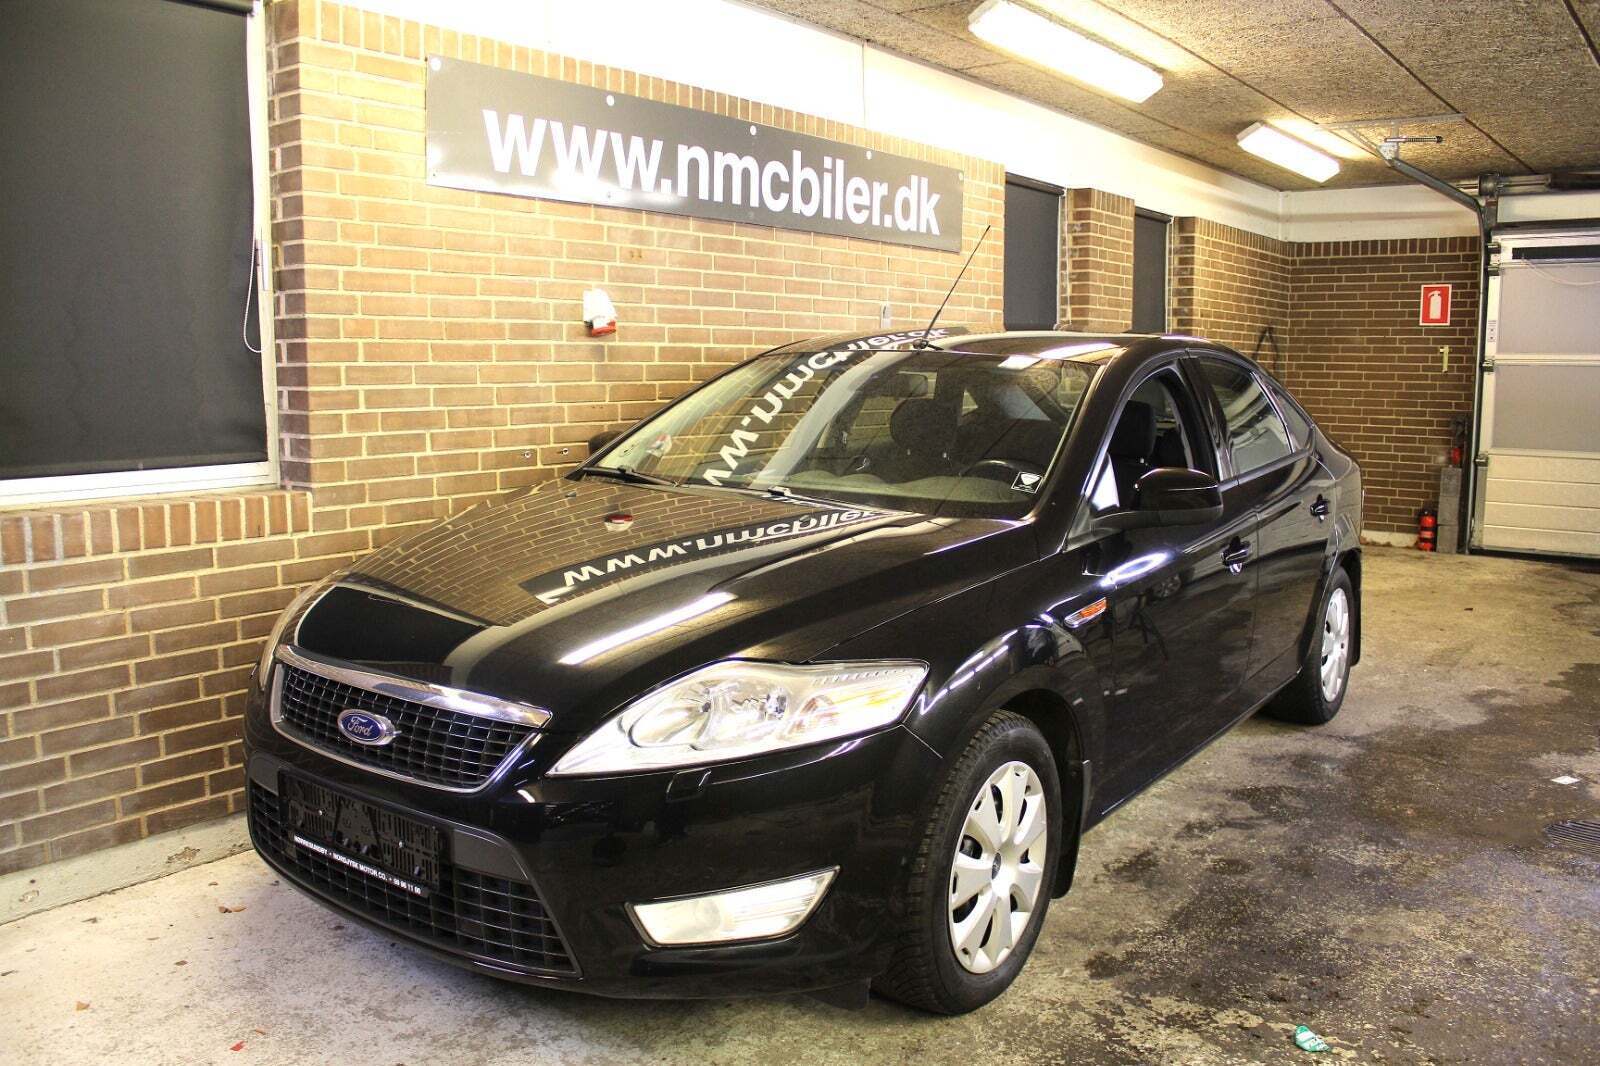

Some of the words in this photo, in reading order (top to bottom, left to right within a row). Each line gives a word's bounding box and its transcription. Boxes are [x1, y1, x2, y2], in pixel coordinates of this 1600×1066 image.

[482, 108, 941, 236] www.nmcbiler.dk
[347, 716, 374, 737] Ford
[359, 864, 378, 877] MOTOR
